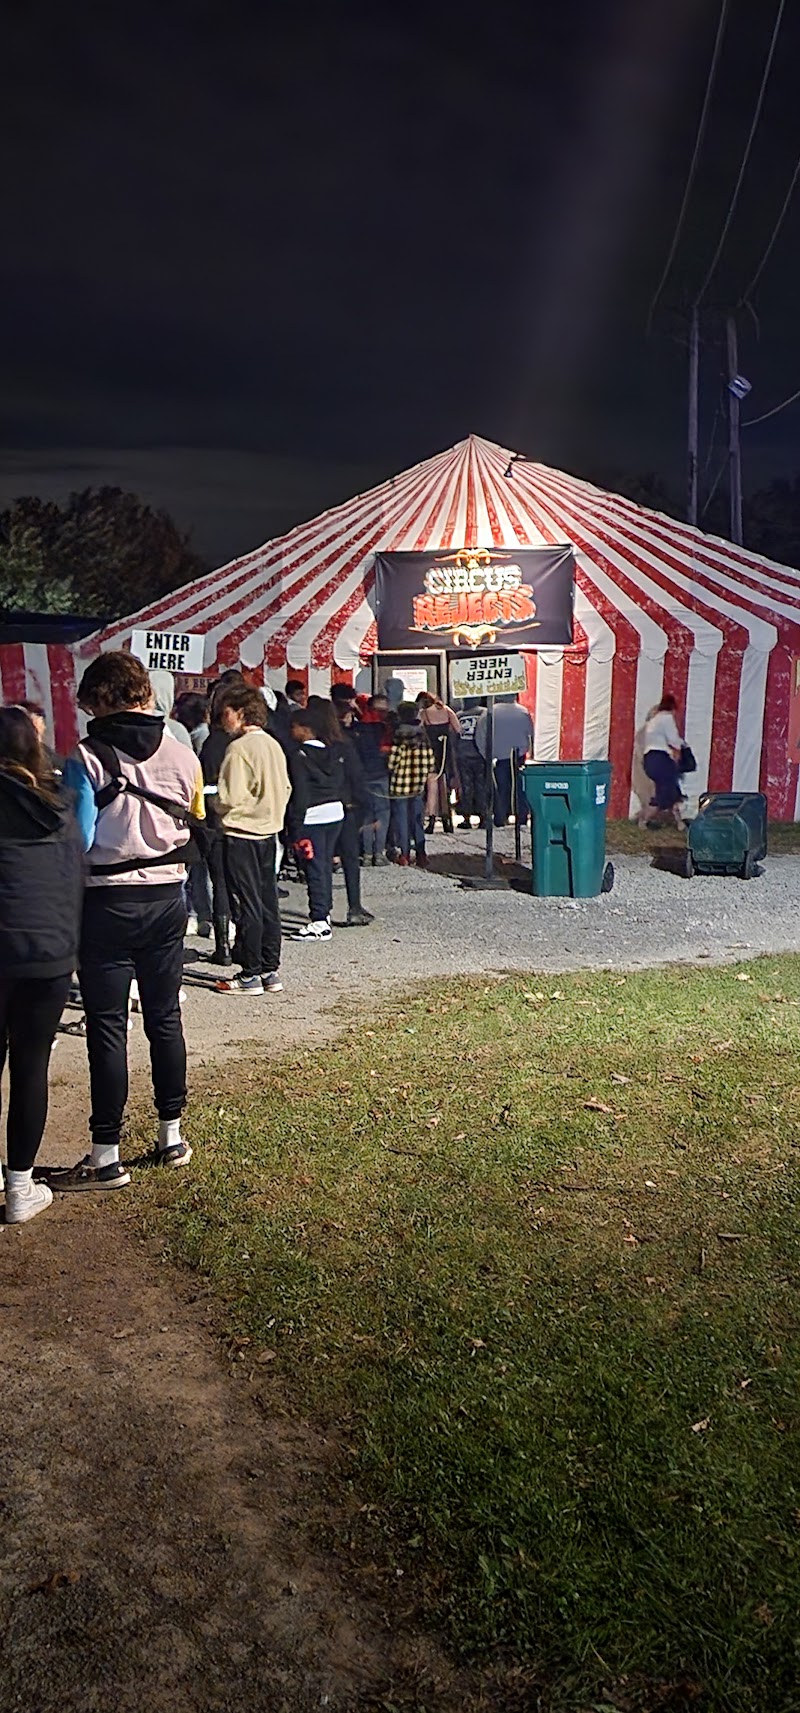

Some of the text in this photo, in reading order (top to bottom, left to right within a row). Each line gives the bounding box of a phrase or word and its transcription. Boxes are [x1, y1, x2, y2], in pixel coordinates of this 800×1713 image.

[424, 565, 521, 594] CIRCUS
[413, 584, 536, 630] REJECTS
[146, 632, 189, 651] ENTER
[149, 652, 185, 670] HERE
[470, 658, 507, 670] HERE
[467, 668, 512, 681] ENTER
